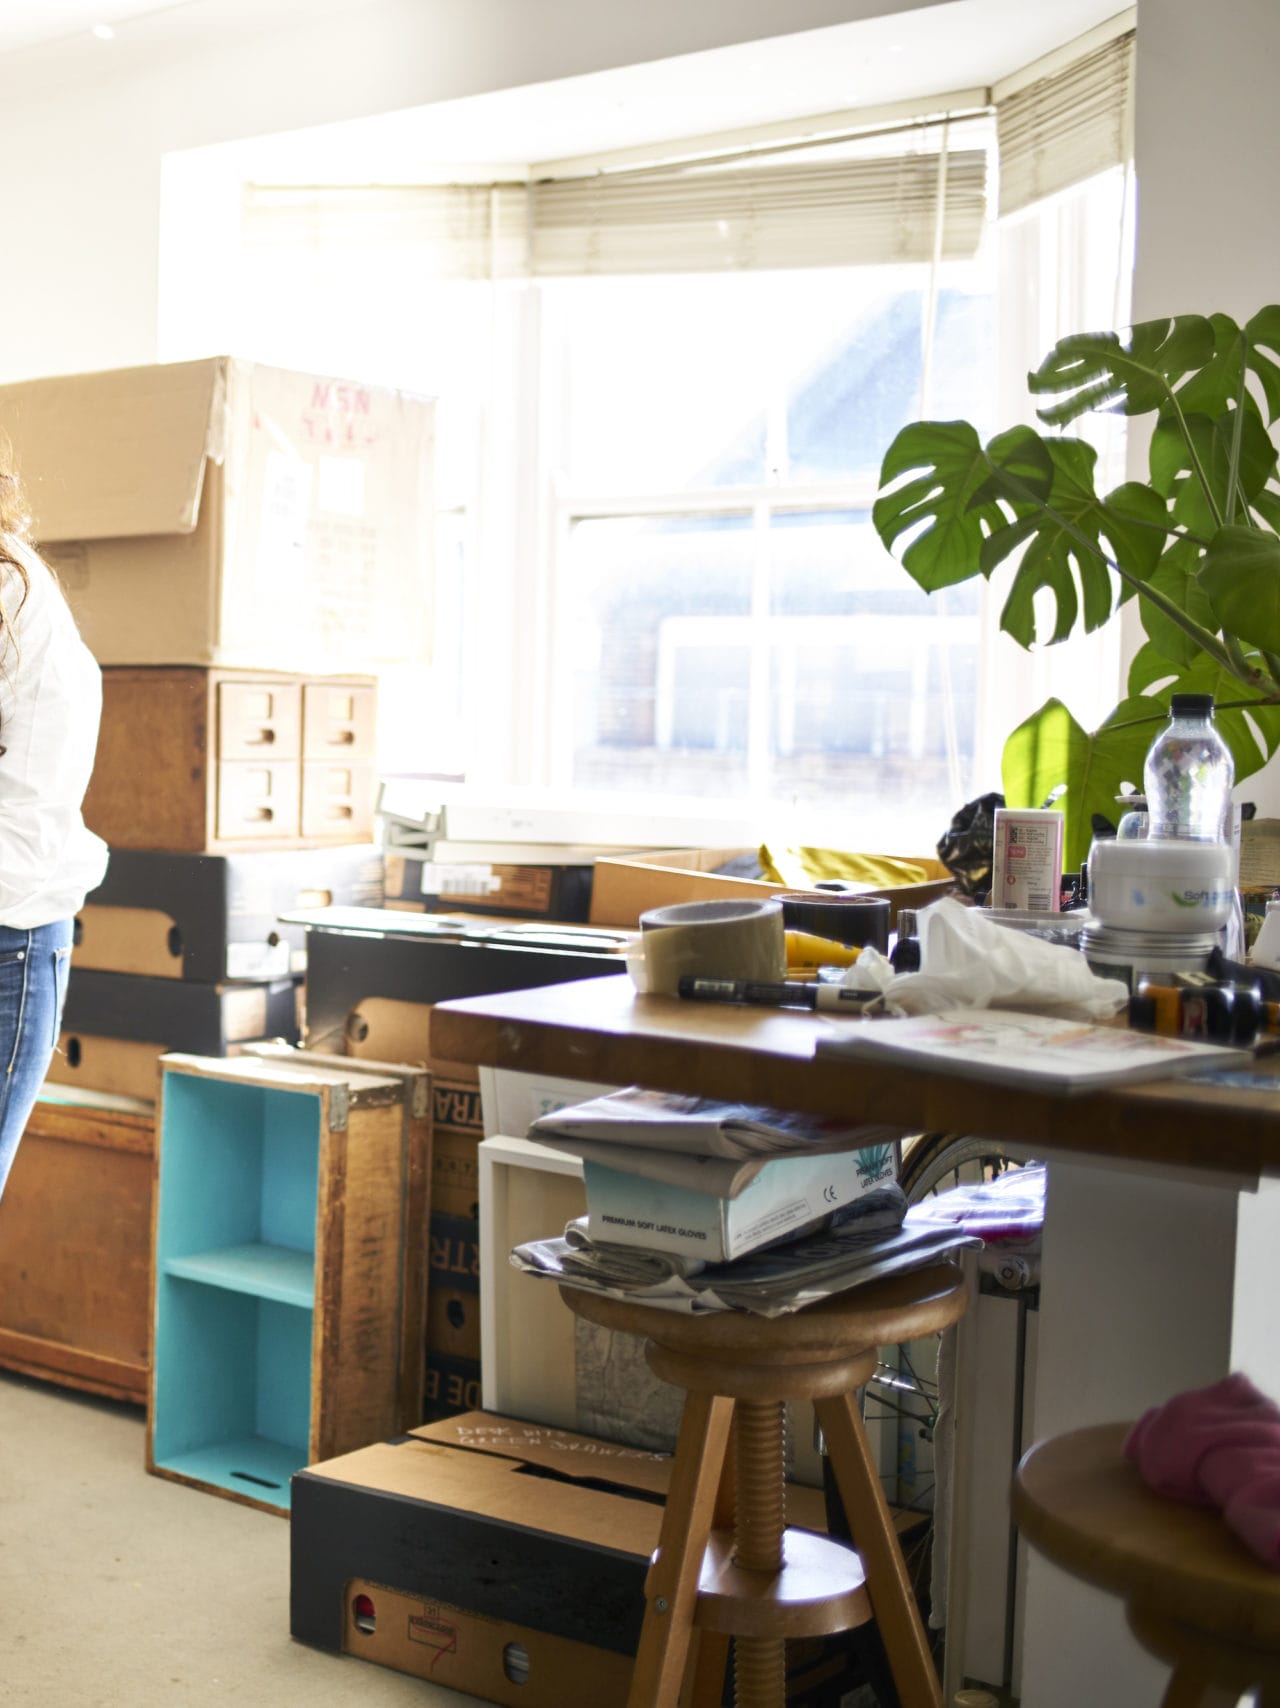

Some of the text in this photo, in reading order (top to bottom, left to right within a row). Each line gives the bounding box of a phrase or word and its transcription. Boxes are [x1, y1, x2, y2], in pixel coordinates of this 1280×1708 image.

[602, 1215, 707, 1240] PREMIUM SOFT LATEX GLOVES
